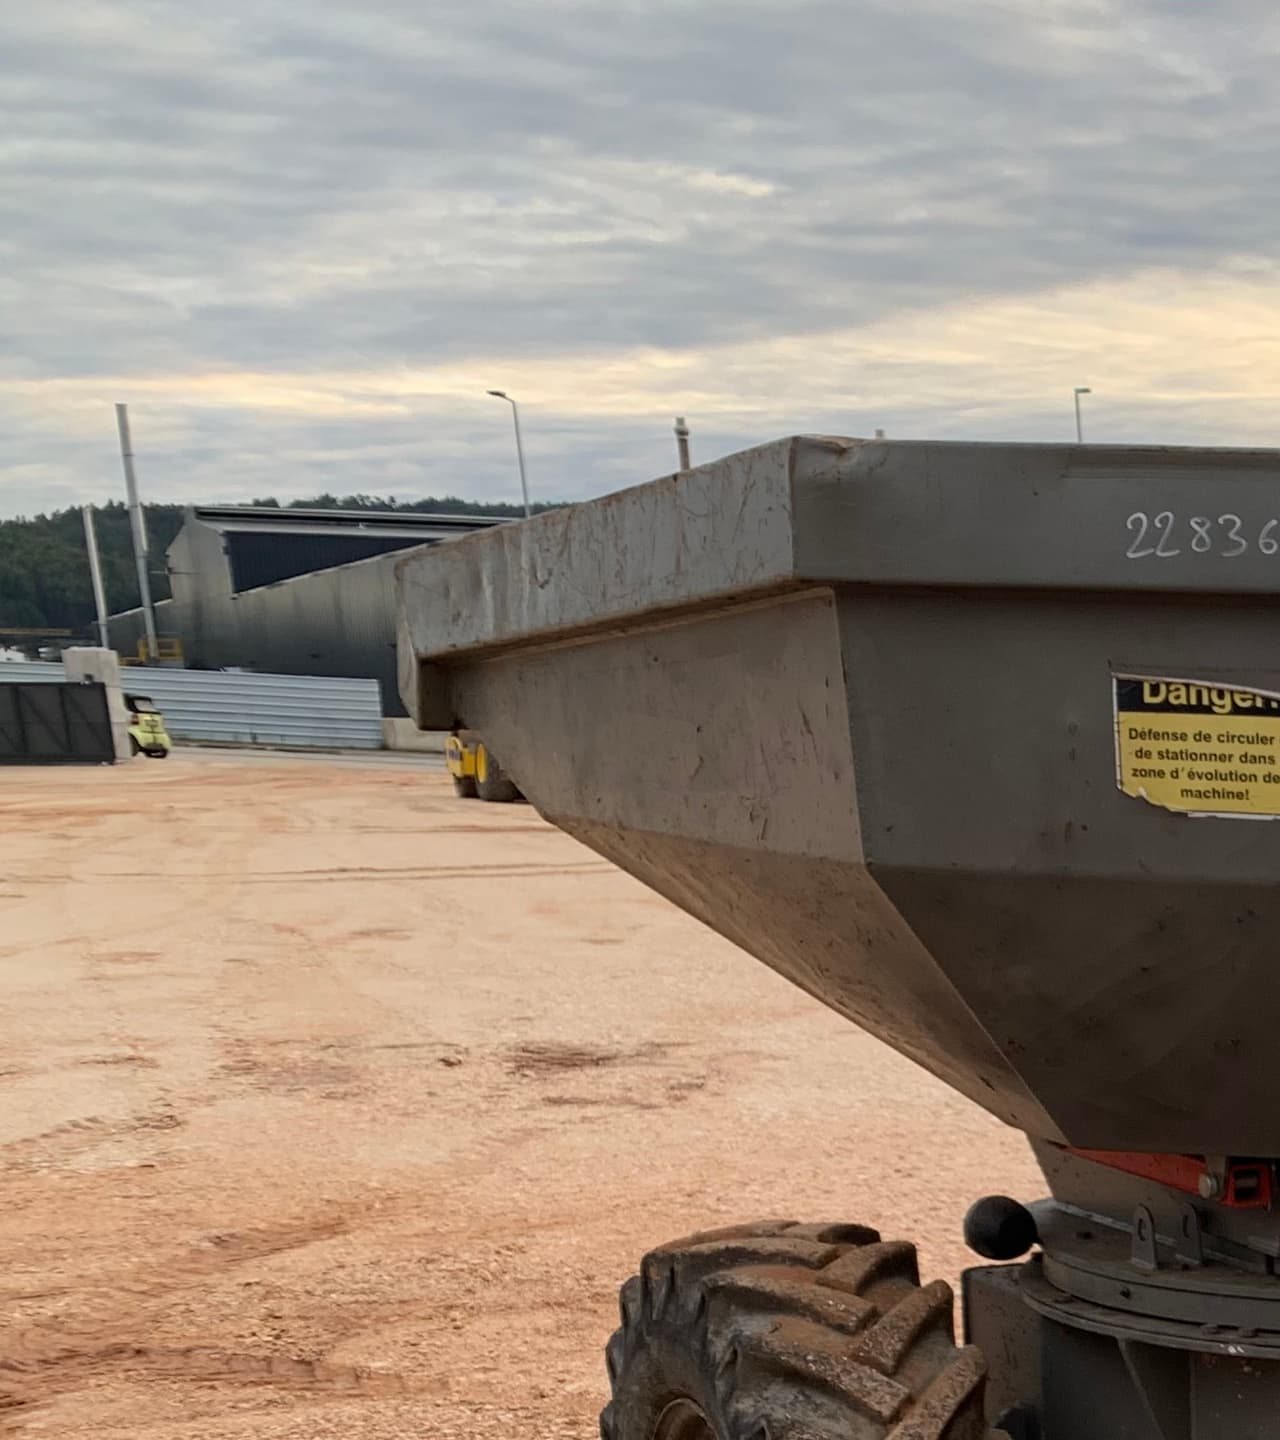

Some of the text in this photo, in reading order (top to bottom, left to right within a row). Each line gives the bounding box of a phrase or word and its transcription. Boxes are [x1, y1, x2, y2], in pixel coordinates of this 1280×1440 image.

[1128, 727, 1188, 742] Défense
[1193, 730, 1212, 743] de
[1217, 731, 1275, 746] circuler
[1134, 747, 1152, 760] de
[1157, 748, 1232, 763] stationner
[1239, 751, 1275, 765] dans
[1131, 768, 1166, 779] zone
[1263, 770, 1280, 784] de
[1180, 787, 1250, 801] machine!
